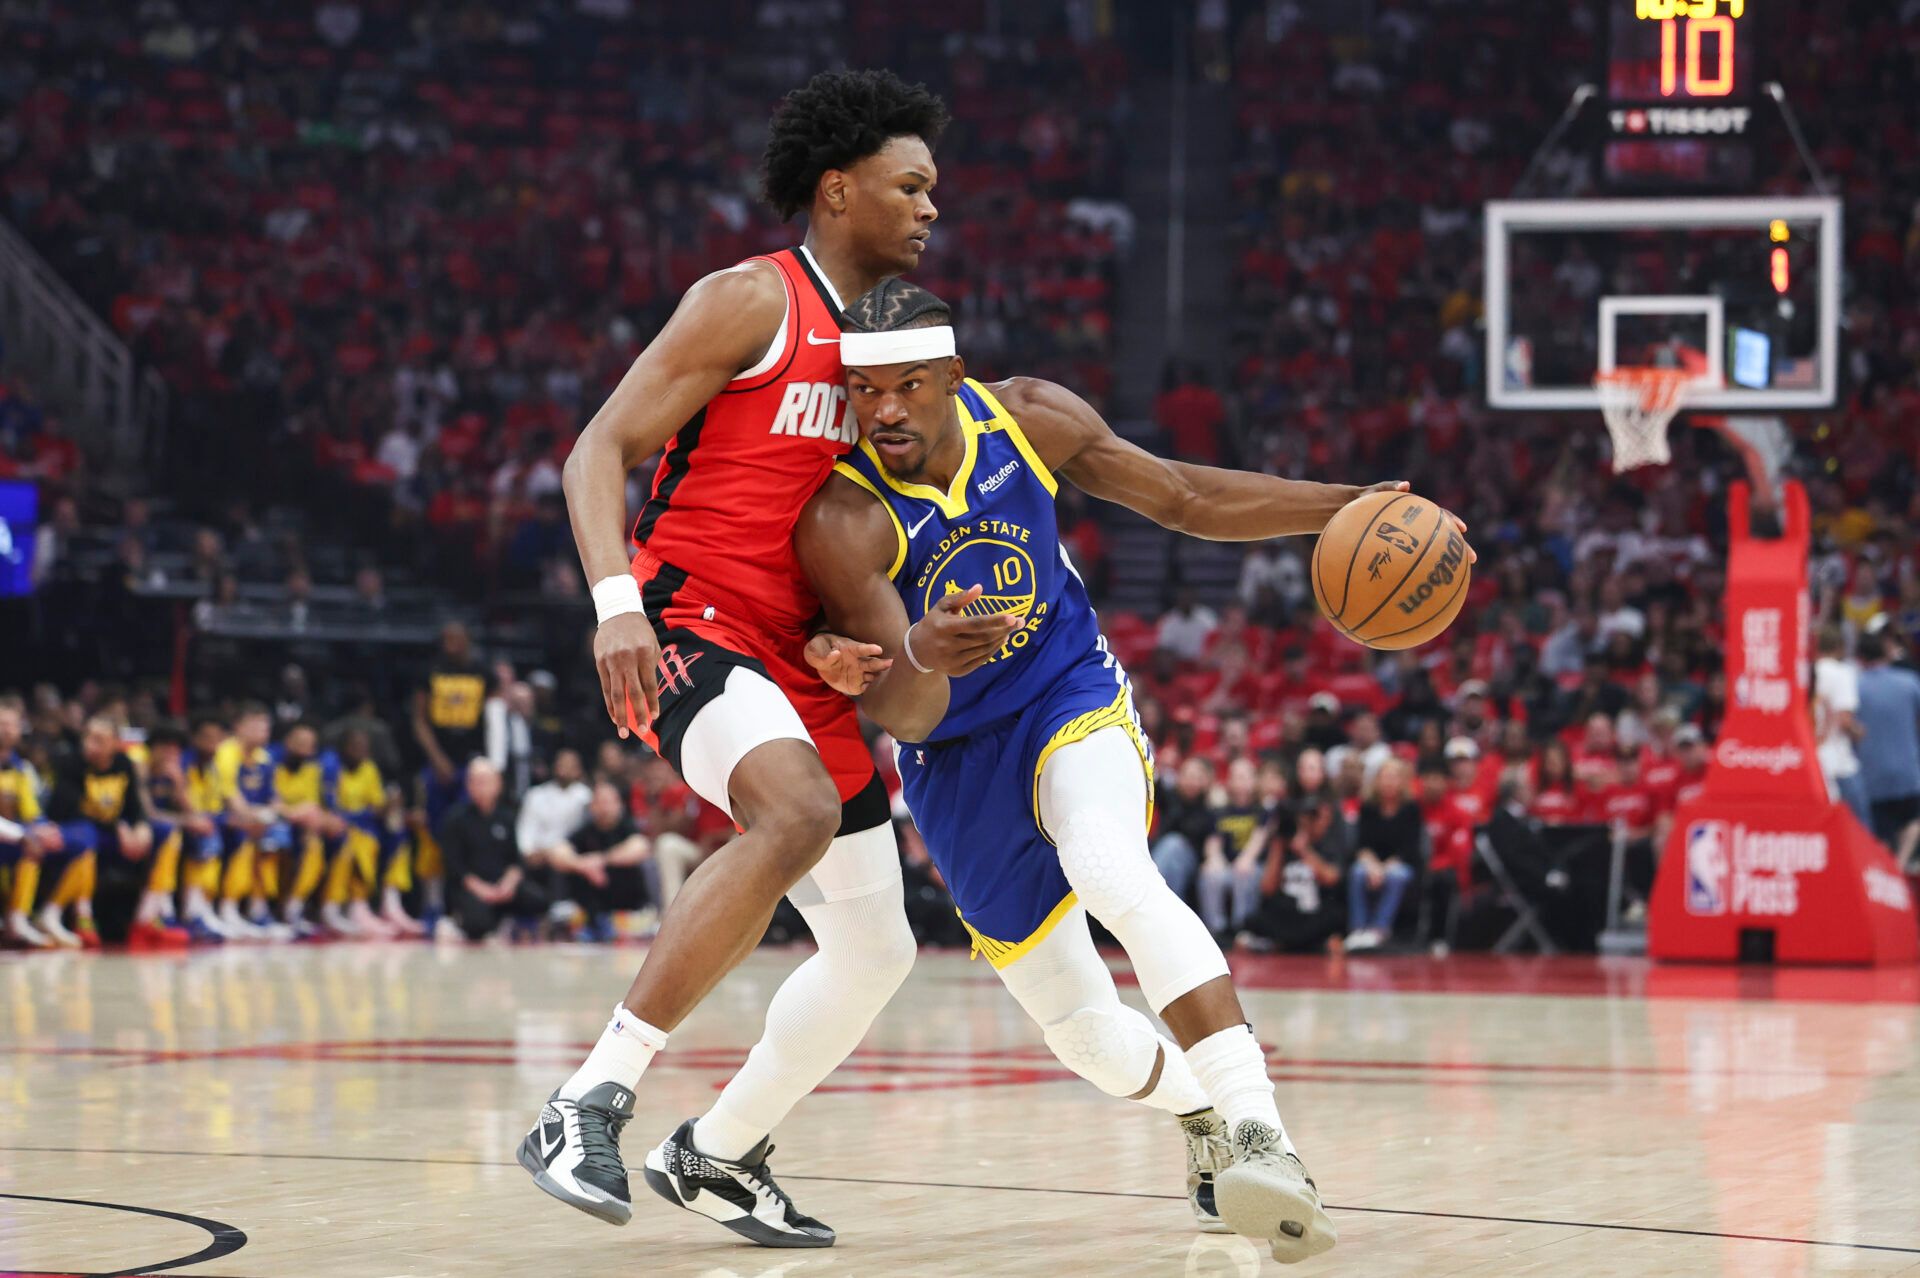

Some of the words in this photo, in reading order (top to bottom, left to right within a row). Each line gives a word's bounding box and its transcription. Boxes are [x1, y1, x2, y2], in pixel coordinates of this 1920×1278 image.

[1661, 15, 1734, 96] 10
[1648, 108, 1750, 134] TISSOT
[978, 460, 1020, 495] Rakuten
[917, 526, 971, 588] GOLDEN
[979, 520, 1031, 543] STATE
[993, 556, 1022, 591] 10
[1717, 738, 1802, 775] Google
[1732, 823, 1828, 873] League
[1731, 872, 1798, 915] Pass
